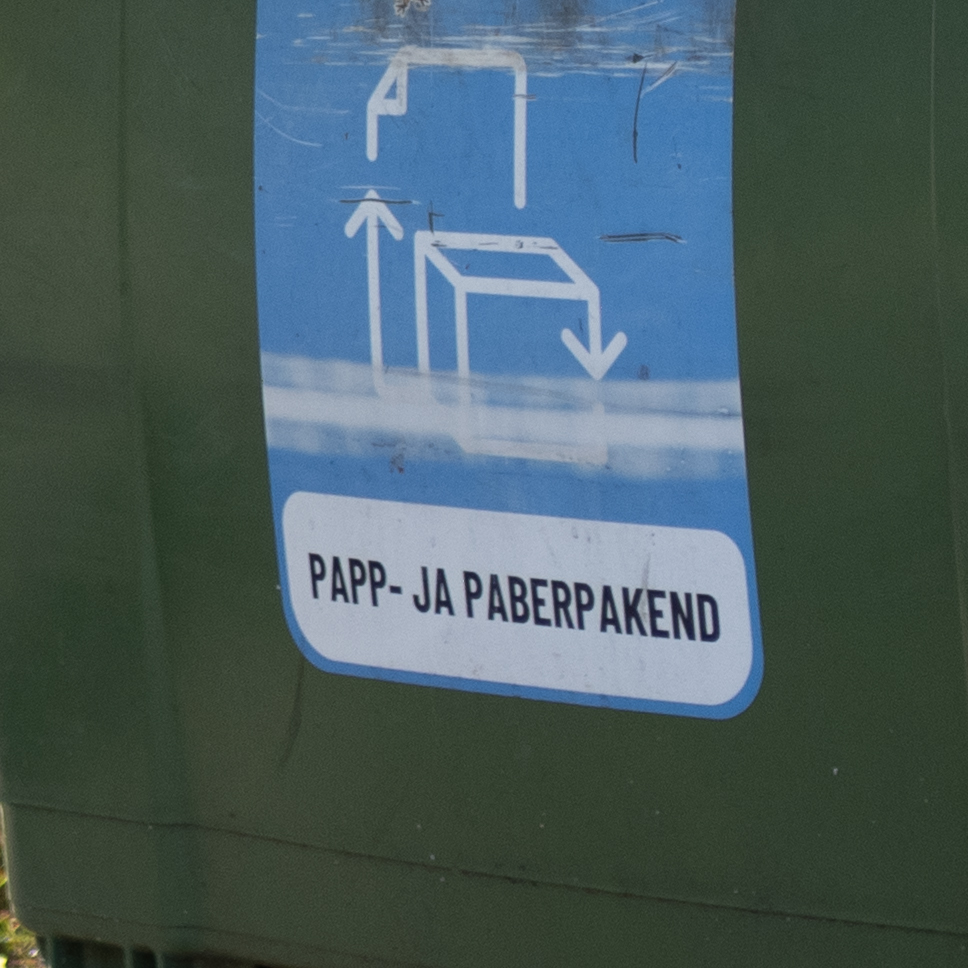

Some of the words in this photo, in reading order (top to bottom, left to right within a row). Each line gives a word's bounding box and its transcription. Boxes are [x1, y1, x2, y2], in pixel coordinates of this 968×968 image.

[308, 552, 403, 607] PAPP-
[412, 565, 455, 616] JA
[463, 570, 721, 643] PABERPAKEND
